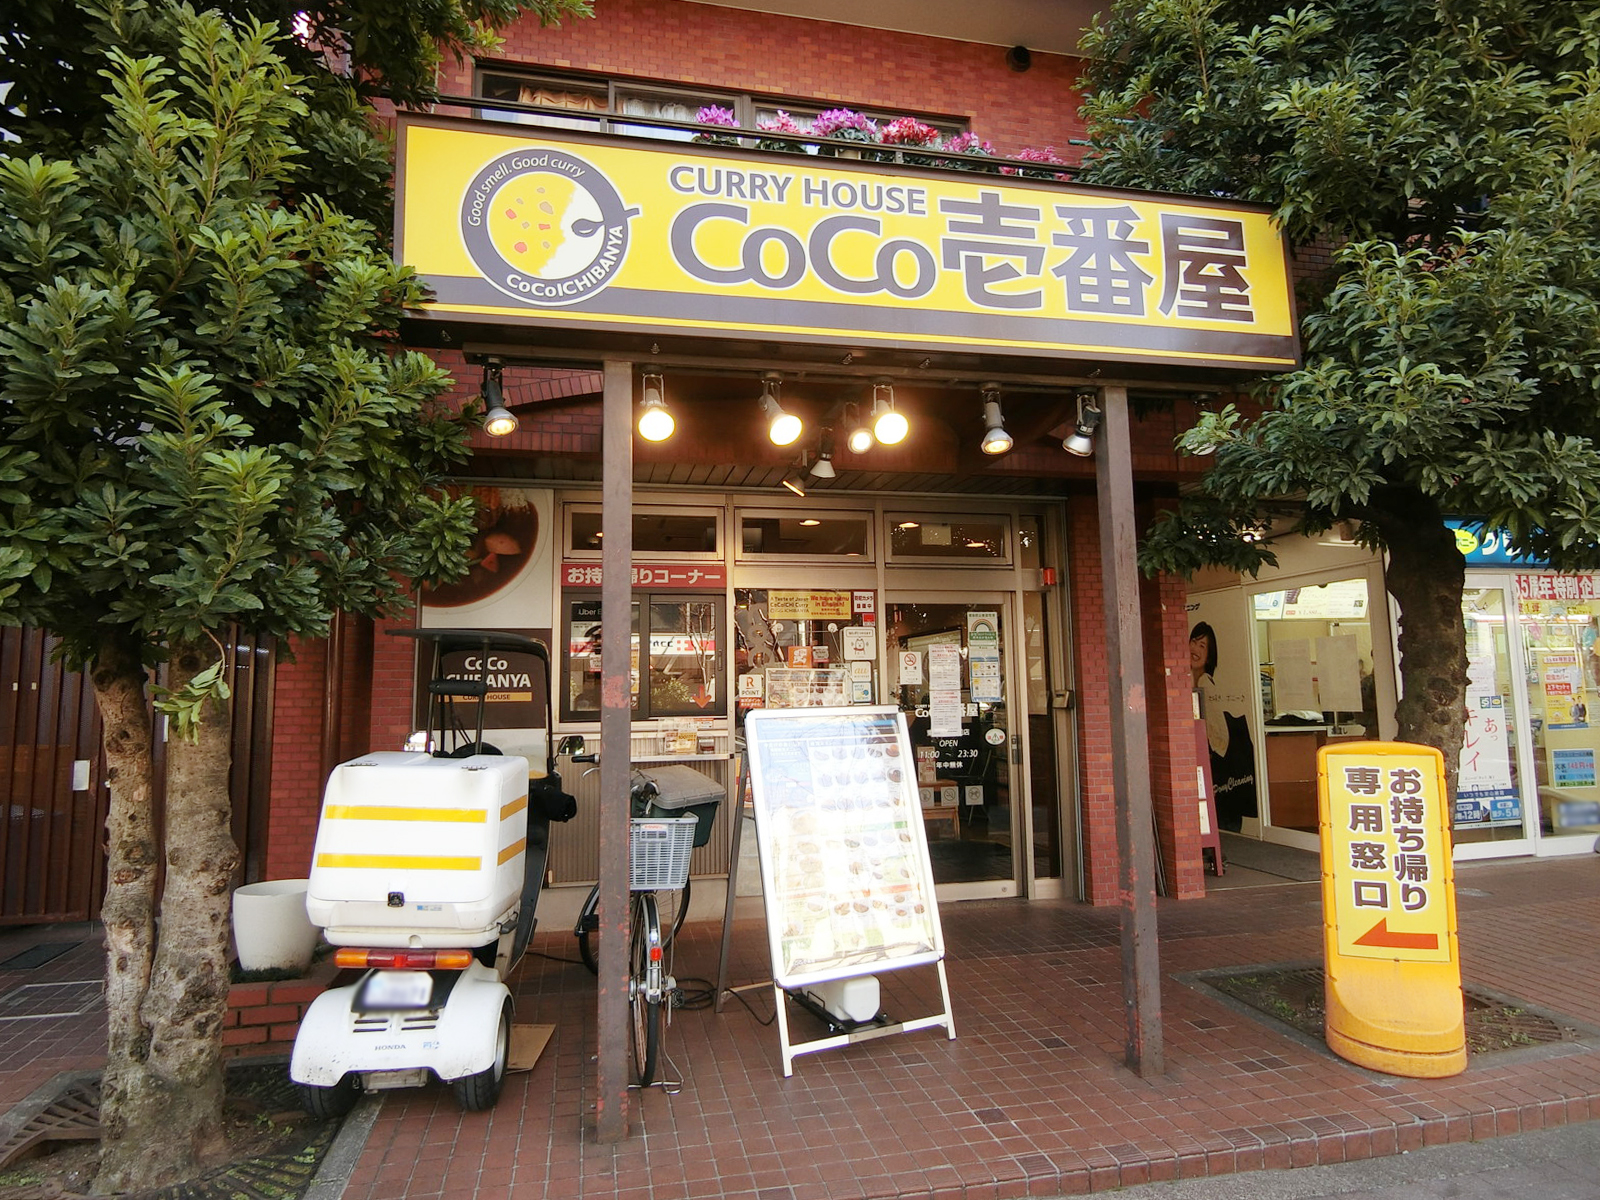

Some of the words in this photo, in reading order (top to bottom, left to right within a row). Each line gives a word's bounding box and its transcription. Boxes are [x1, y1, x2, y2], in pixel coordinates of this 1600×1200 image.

[467, 189, 482, 227] Good
[511, 154, 548, 172] Good
[550, 155, 586, 178] curry
[670, 165, 793, 204] CURRY
[803, 177, 926, 215] HOUSE
[567, 567, 721, 585] お持りコーナー
[578, 608, 596, 616] Uber
[746, 676, 755, 687] R
[938, 739, 959, 747] OPEN
[920, 750, 940, 758] 11:00
[957, 749, 979, 758] 23:30
[1345, 766, 1389, 910] 専用窓口
[1389, 768, 1429, 912] お持ち帰り
